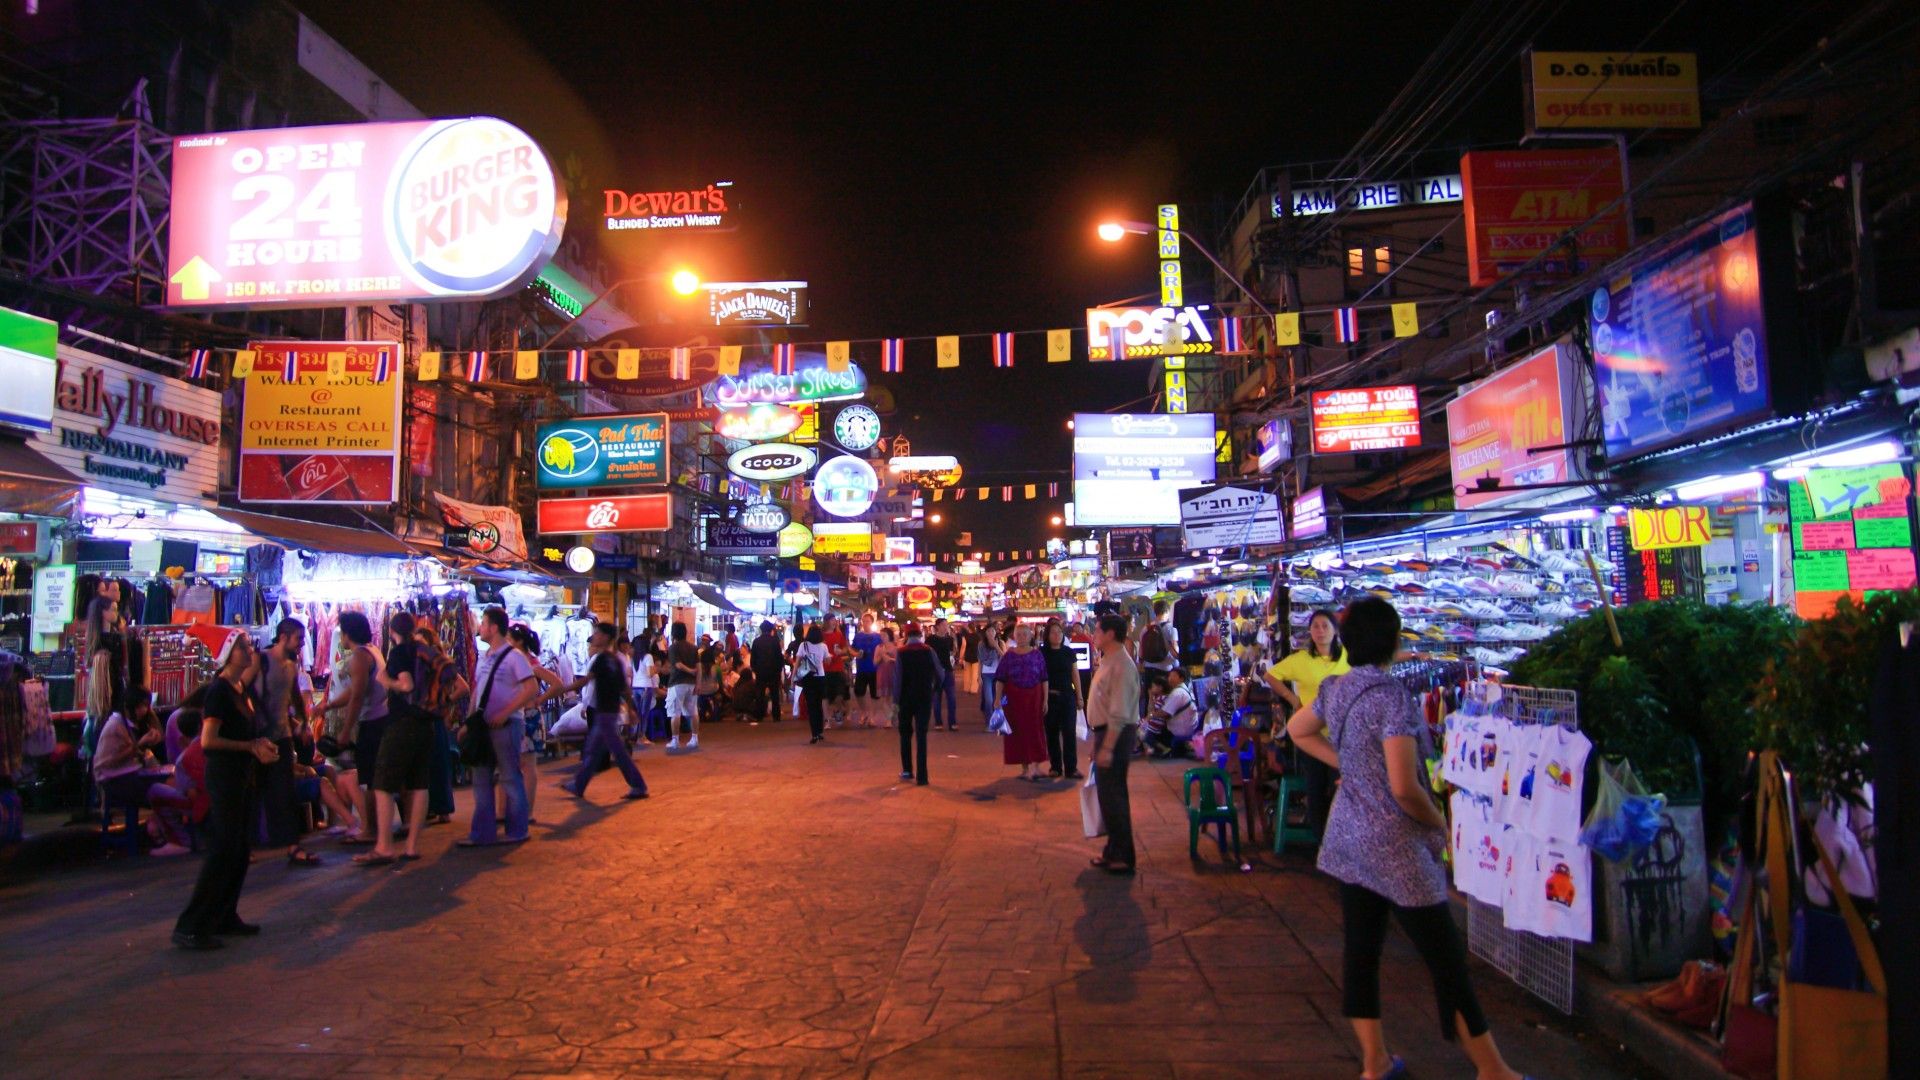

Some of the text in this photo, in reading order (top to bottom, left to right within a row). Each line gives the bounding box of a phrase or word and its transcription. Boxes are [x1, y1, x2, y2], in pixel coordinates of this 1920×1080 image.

[1547, 102, 1692, 117] GUEST HOUSE
[231, 141, 366, 174] OPEN
[410, 145, 533, 213] BURGER
[1347, 178, 1460, 207] ORIENTAL
[229, 171, 363, 241] 24
[1511, 189, 1590, 221] ATM
[414, 175, 539, 258] KING
[1160, 206, 1180, 256] SIAM
[1490, 233, 1616, 249] EXCHNGE
[226, 237, 362, 267] HOURS
[226, 275, 402, 297] 150 M. FROM HERE
[719, 296, 747, 318] JACK
[56, 358, 220, 445] ally House
[1375, 390, 1414, 401] TOUR
[280, 404, 361, 416] Restaurant
[250, 420, 390, 432] OVERSEAS CALL
[631, 423, 665, 441] Thai
[1392, 426, 1419, 436] CALL
[1512, 397, 1549, 450] ATM
[258, 436, 380, 447] Internet Printer
[601, 441, 661, 451] RESTAURANT
[1350, 438, 1405, 451] INTERNET
[1457, 441, 1501, 470] EXCHANGE
[742, 513, 784, 527] TATTOO
[1631, 506, 1711, 547] DIOR
[715, 537, 772, 546] Yui Silver
